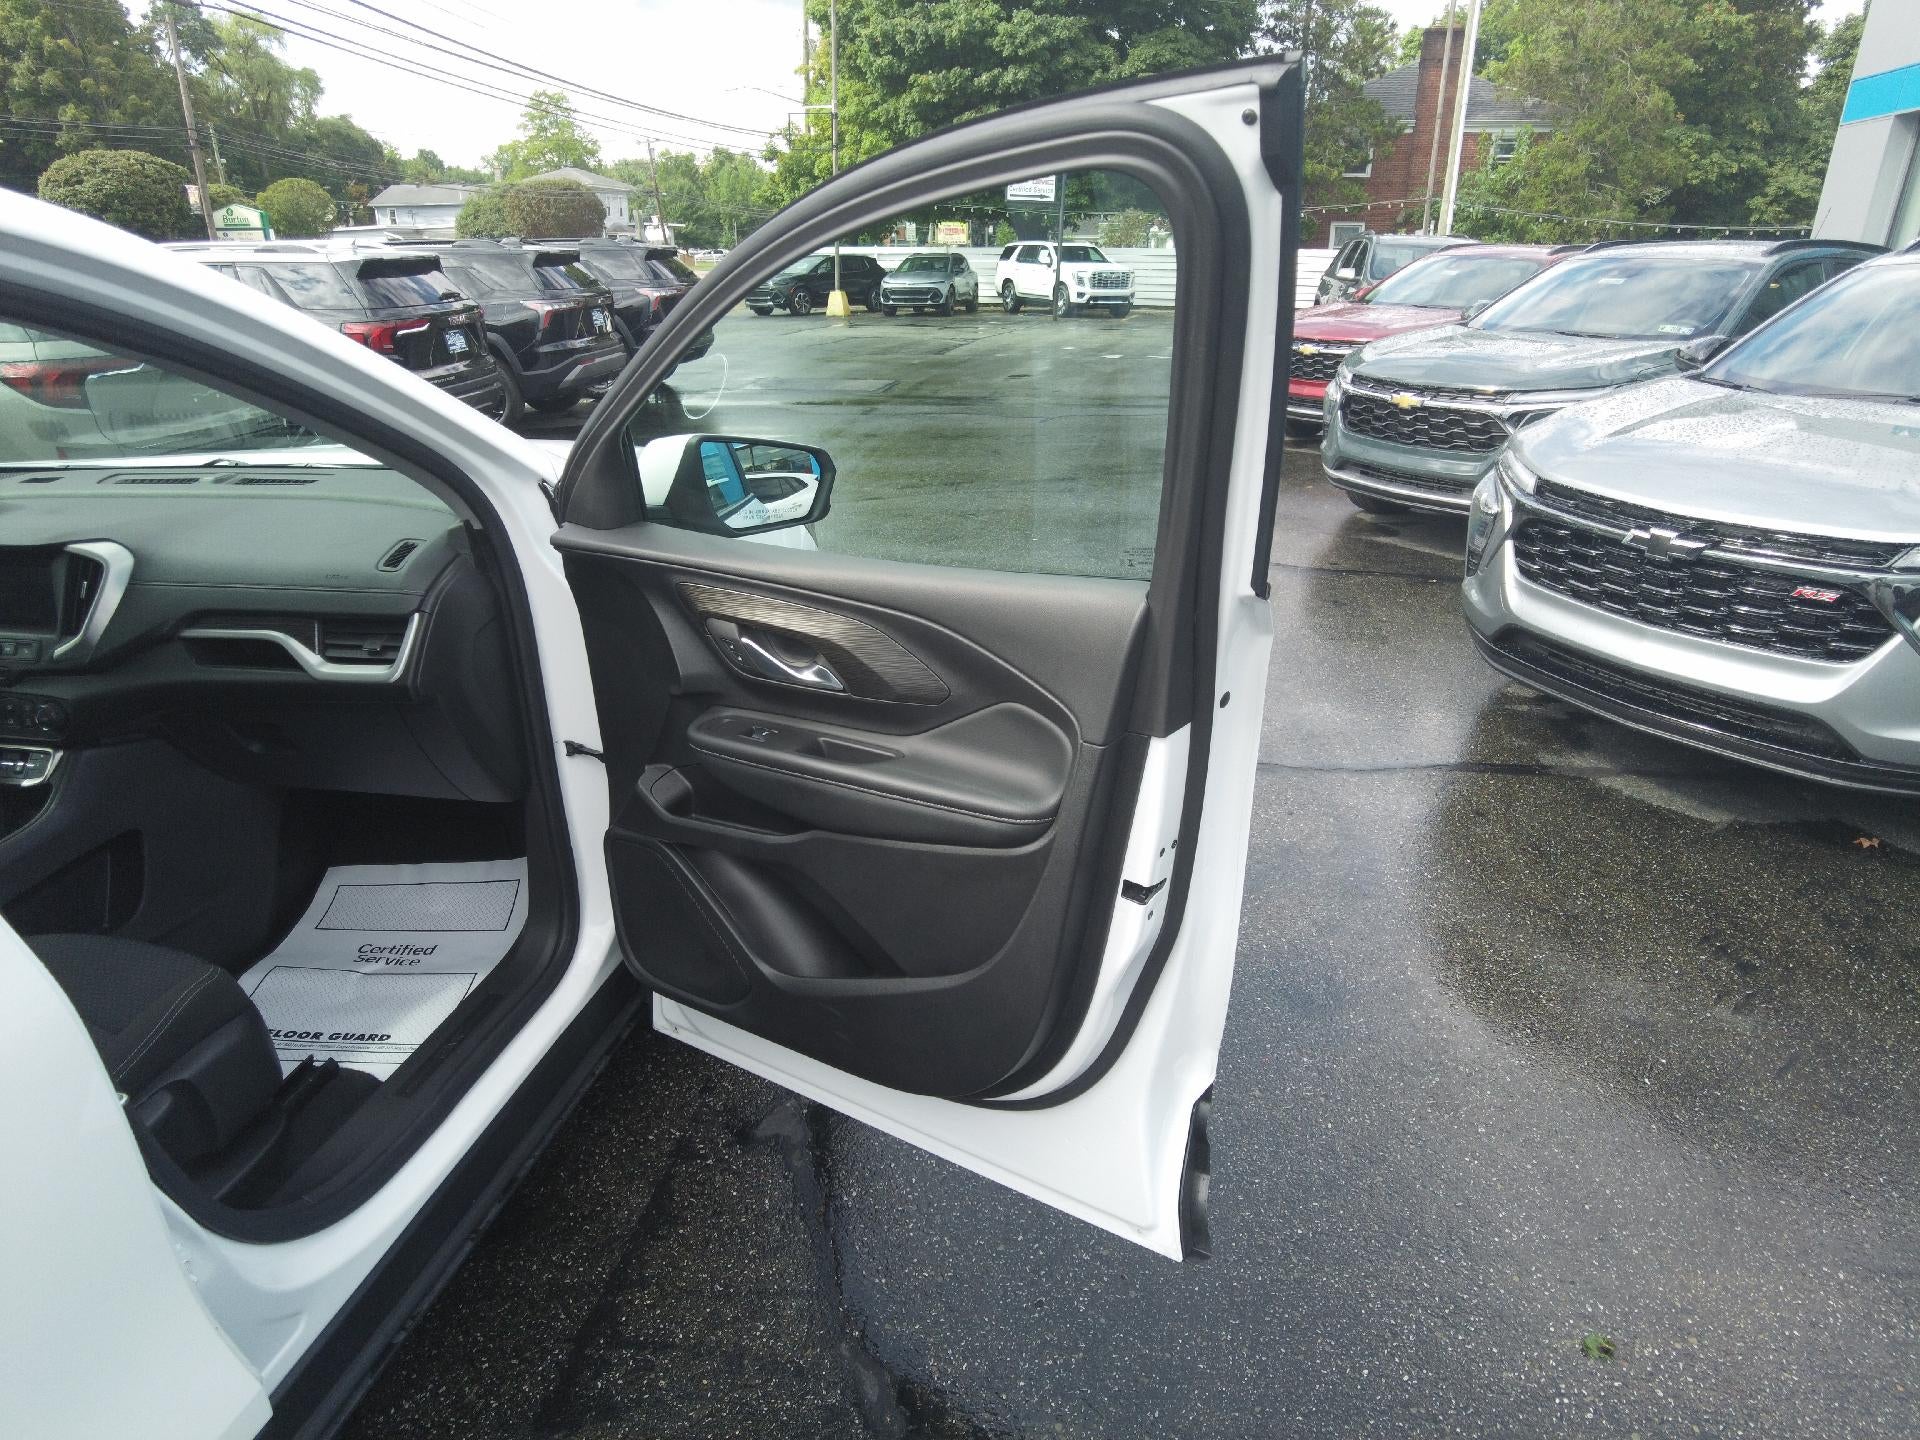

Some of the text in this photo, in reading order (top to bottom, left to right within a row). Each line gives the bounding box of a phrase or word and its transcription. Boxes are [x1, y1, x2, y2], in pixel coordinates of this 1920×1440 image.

[1033, 186, 1054, 194] Service
[1790, 588, 1841, 602] RS
[357, 943, 439, 956] Certified
[352, 954, 421, 966] Service
[328, 1032, 392, 1041] GUARD
